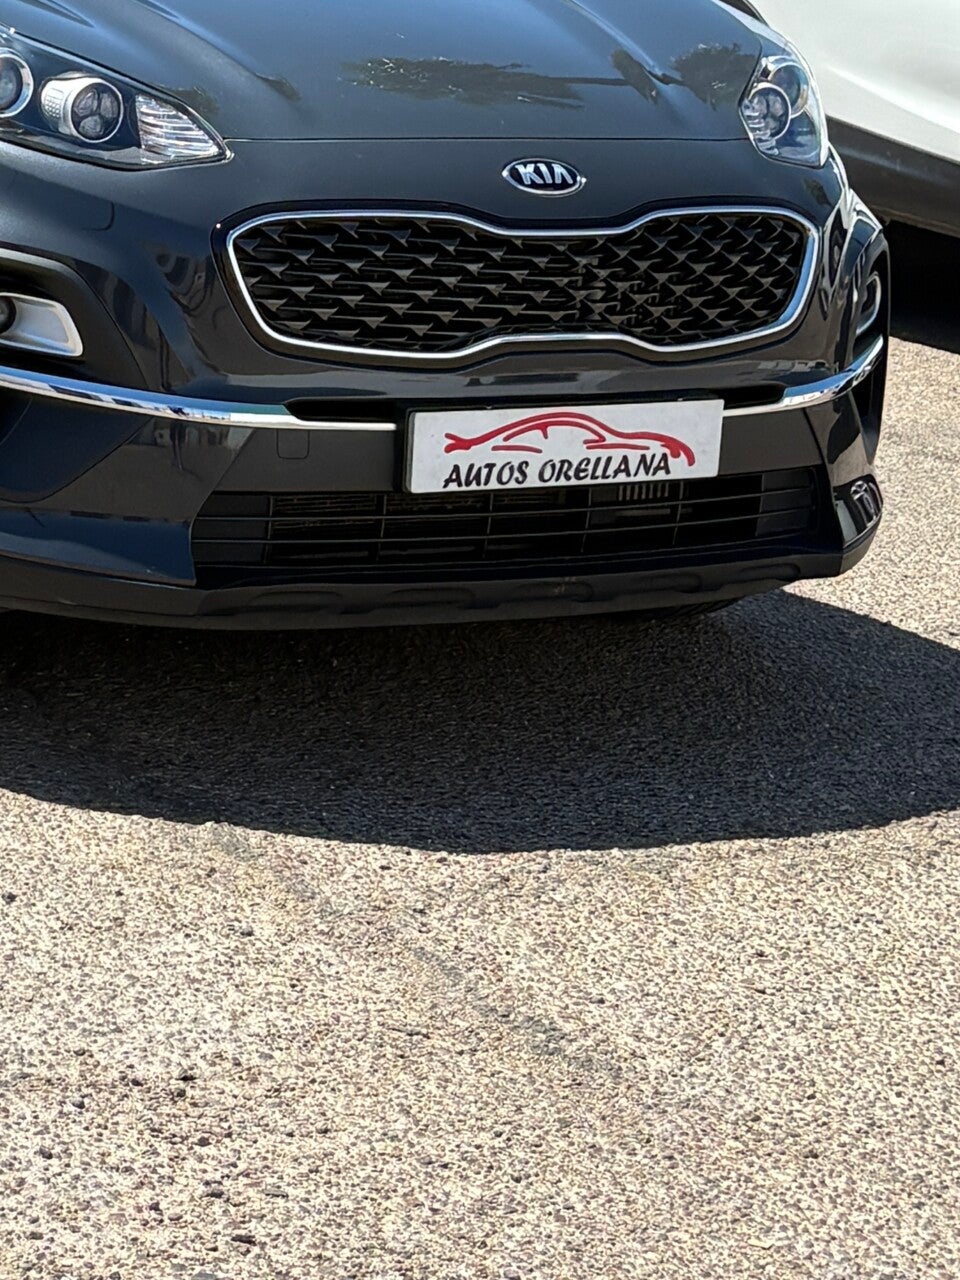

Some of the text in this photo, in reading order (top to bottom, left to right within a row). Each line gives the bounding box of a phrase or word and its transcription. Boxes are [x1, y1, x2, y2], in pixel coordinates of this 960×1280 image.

[514, 163, 573, 185] KIA
[442, 452, 671, 489] AUTOS ORELLANA
